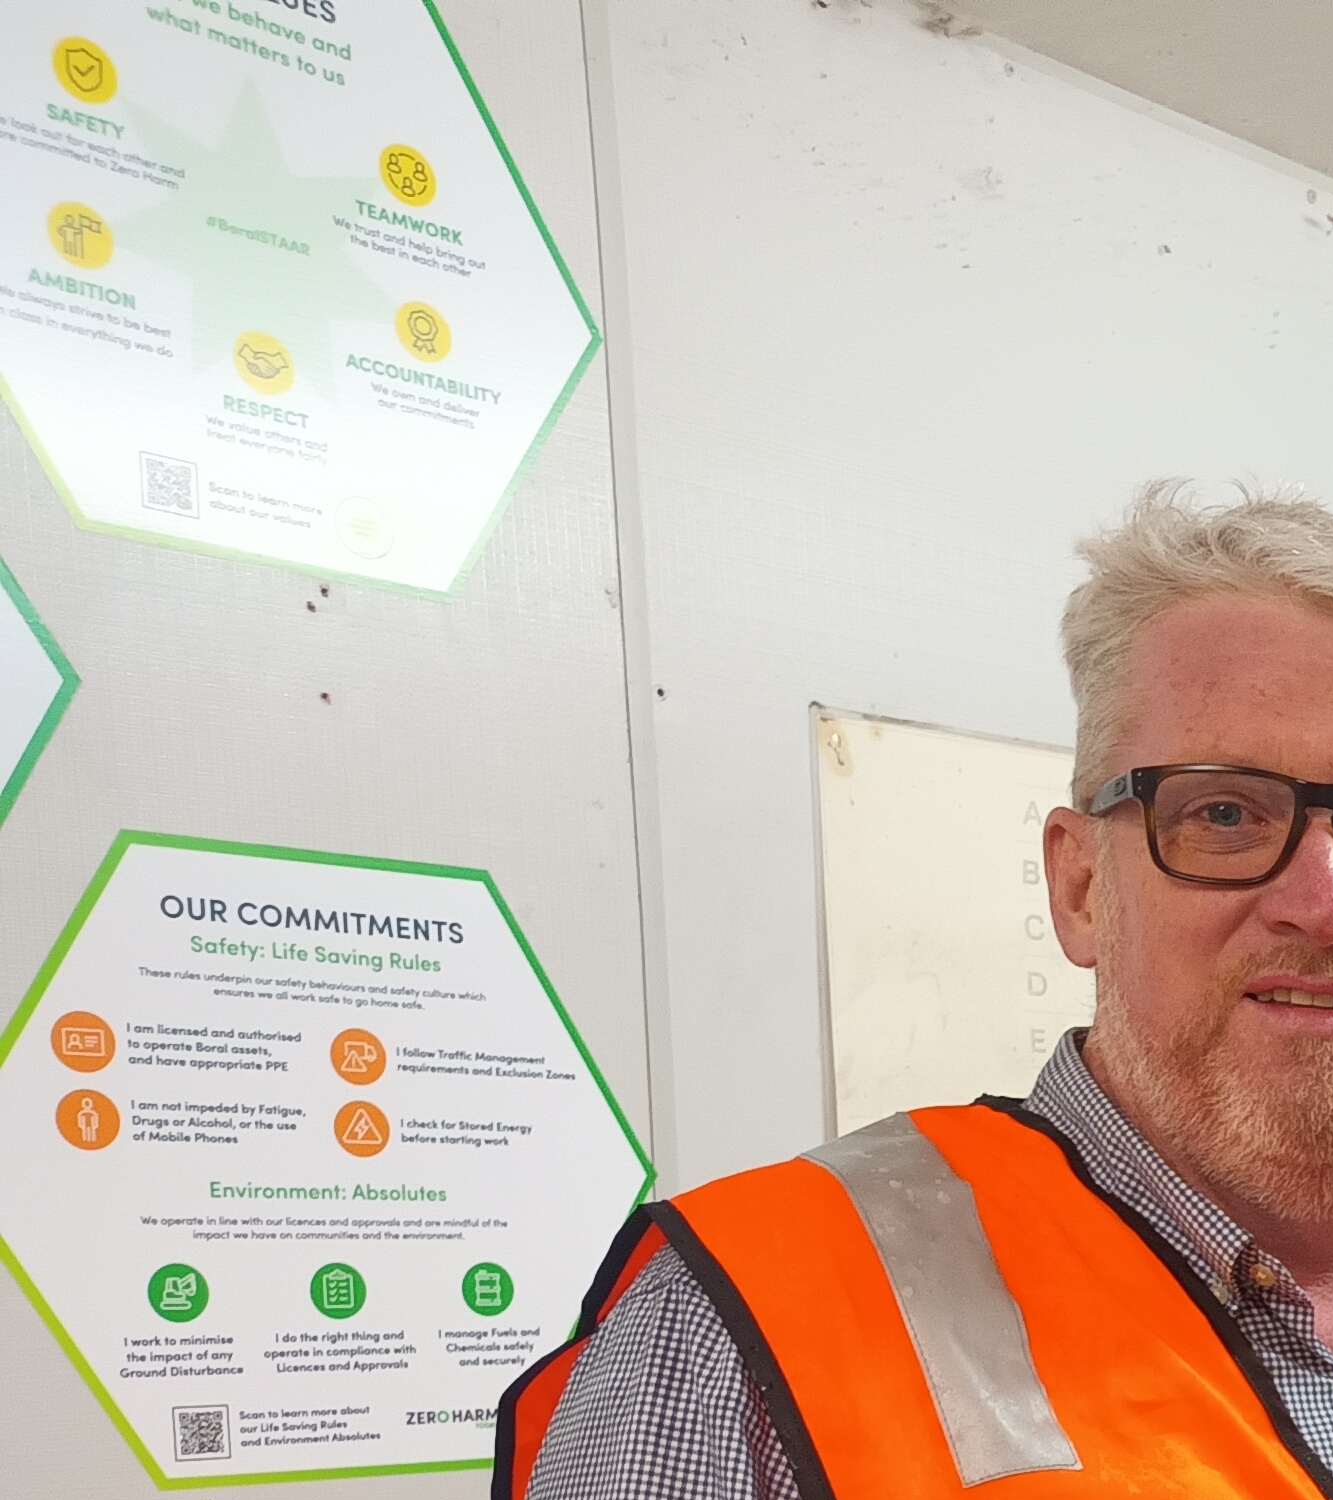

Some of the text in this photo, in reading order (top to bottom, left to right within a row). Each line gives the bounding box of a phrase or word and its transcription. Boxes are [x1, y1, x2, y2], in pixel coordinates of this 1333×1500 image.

[228, 2, 305, 44] behave
[312, 37, 352, 60] and
[146, 6, 345, 86] what matters to us
[46, 103, 125, 140] SAFETY
[355, 199, 463, 246] TEAMWORK
[28, 268, 136, 310] AMBITION
[346, 353, 501, 405] ACCOUNTABILITY
[224, 394, 310, 430] RESPECT
[1024, 800, 1043, 826] A
[1023, 859, 1041, 885] B
[159, 894, 464, 944] OUR COMMITMENTS
[1025, 915, 1046, 942] C
[190, 935, 442, 973] Safety: Life Saving Rules
[1028, 971, 1047, 997] D
[126, 1022, 302, 1043] I am licensed and authorised
[1031, 1027, 1048, 1054] E
[127, 1038, 273, 1058] to operate Boral assets,
[395, 1046, 546, 1066] I follow Traffic Management
[127, 1054, 289, 1072] and have appropriate PPE
[396, 1063, 576, 1081] requirements and Exclusion Zones
[130, 1099, 307, 1118] I am not impeded by Fatigue,
[131, 1115, 297, 1131] Drugs or Alcohol, or the use
[400, 1118, 533, 1136] I check for Stored Energy
[132, 1130, 239, 1144] of Mobile Phones
[400, 1133, 509, 1148] before starting work
[209, 1181, 447, 1202] Environment: Absolutes
[123, 1334, 234, 1347] I work to minimise
[275, 1329, 405, 1345] I do the right thing and
[437, 1326, 541, 1341] I manage Fuels and
[263, 1344, 417, 1361] operate in compliance with
[445, 1341, 534, 1353] Chemicals safely
[126, 1349, 234, 1364] the impact of any
[458, 1355, 526, 1367] and securely
[119, 1365, 244, 1379] Ground Disturbance
[276, 1359, 409, 1374] Licences and Approvals
[238, 1405, 370, 1421] Scan to learn more about
[406, 1411, 449, 1425] ZERO
[239, 1419, 348, 1434] our Life Saving Rules
[240, 1431, 381, 1448] and Environment Absolutes
